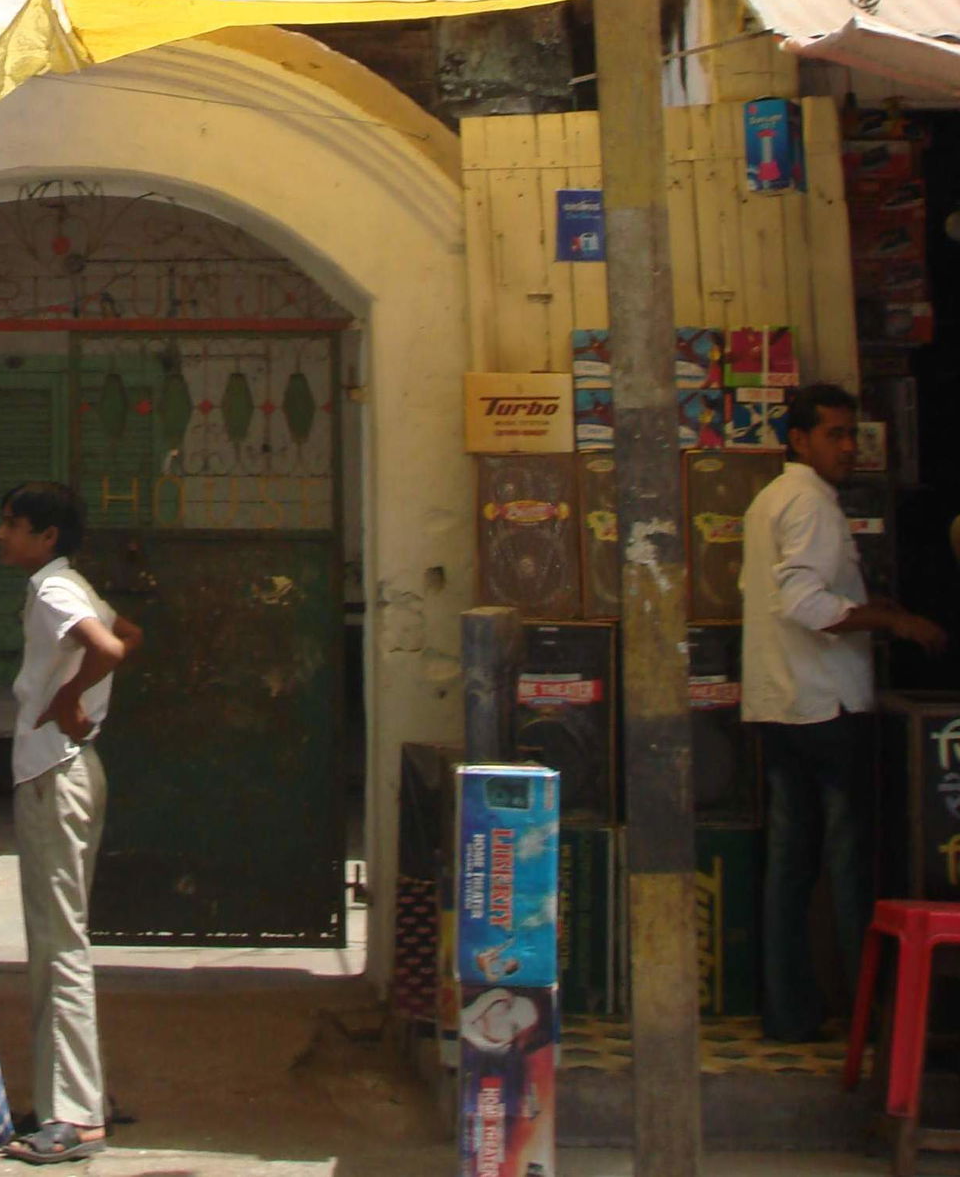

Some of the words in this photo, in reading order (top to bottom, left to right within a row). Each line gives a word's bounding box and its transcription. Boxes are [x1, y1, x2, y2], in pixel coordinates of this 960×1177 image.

[480, 396, 561, 417] Turbo
[101, 474, 325, 528] HOUSE
[473, 833, 487, 868] HOME
[488, 827, 516, 930] LIBERTY
[481, 1087, 502, 1118] HOME
